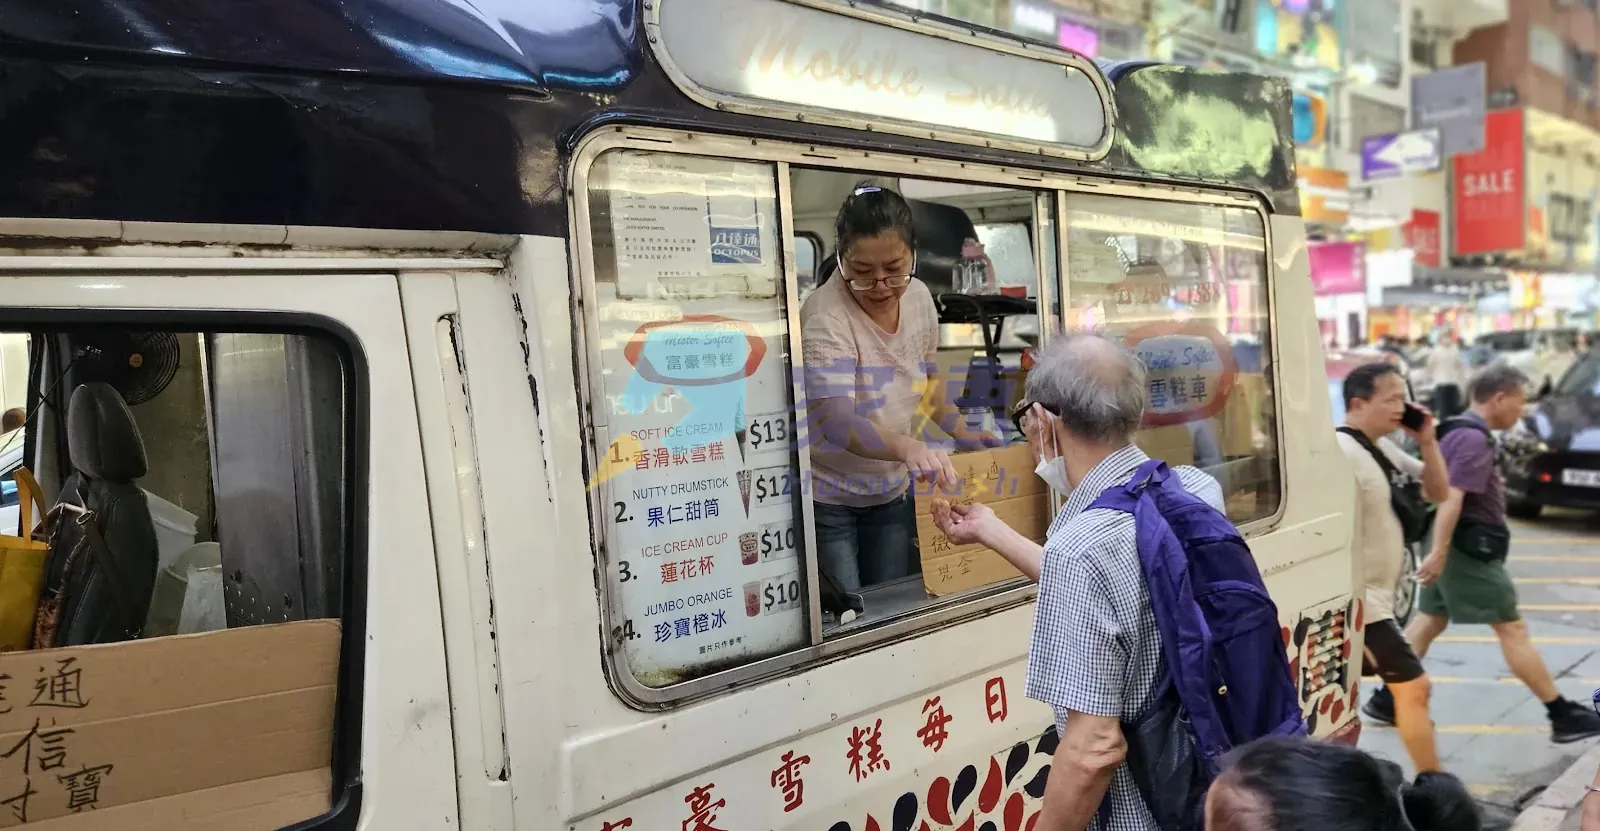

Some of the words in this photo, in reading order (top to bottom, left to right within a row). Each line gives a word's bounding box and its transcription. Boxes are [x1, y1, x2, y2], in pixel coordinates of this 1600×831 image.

[738, 18, 923, 97] Mobile
[1463, 169, 1516, 197] SALE
[714, 231, 758, 246] 八達通
[712, 249, 759, 257] OCTOPUS
[664, 336, 701, 346] Mister
[703, 334, 735, 348] Softee
[665, 353, 735, 371] 富豪雪糕
[1150, 375, 1208, 408] 雪糕車
[631, 428, 661, 441] SOFT
[664, 426, 684, 438] ICE
[685, 422, 724, 436] CREAM
[750, 418, 788, 449] $13
[609, 441, 630, 463] 1.
[633, 441, 725, 471] 香滑軟雪糕
[632, 485, 668, 500] NUTTY
[671, 477, 729, 495] DRUMSTICK
[756, 474, 791, 503] $12
[614, 501, 634, 523] 2.
[647, 498, 720, 527] 果仁甜筒
[641, 544, 661, 558] ICE
[664, 537, 704, 554] CREAM
[707, 532, 728, 546] CUP
[761, 527, 795, 558] $10
[618, 560, 638, 583] 3.
[660, 555, 715, 584] 蓮花杯
[644, 598, 684, 617] JUMBO
[687, 587, 733, 607] ORANGE
[764, 580, 799, 611] $10
[623, 620, 642, 641] 4.
[654, 608, 727, 643] 珍寶橙冰
[1, 717, 77, 774] 信
